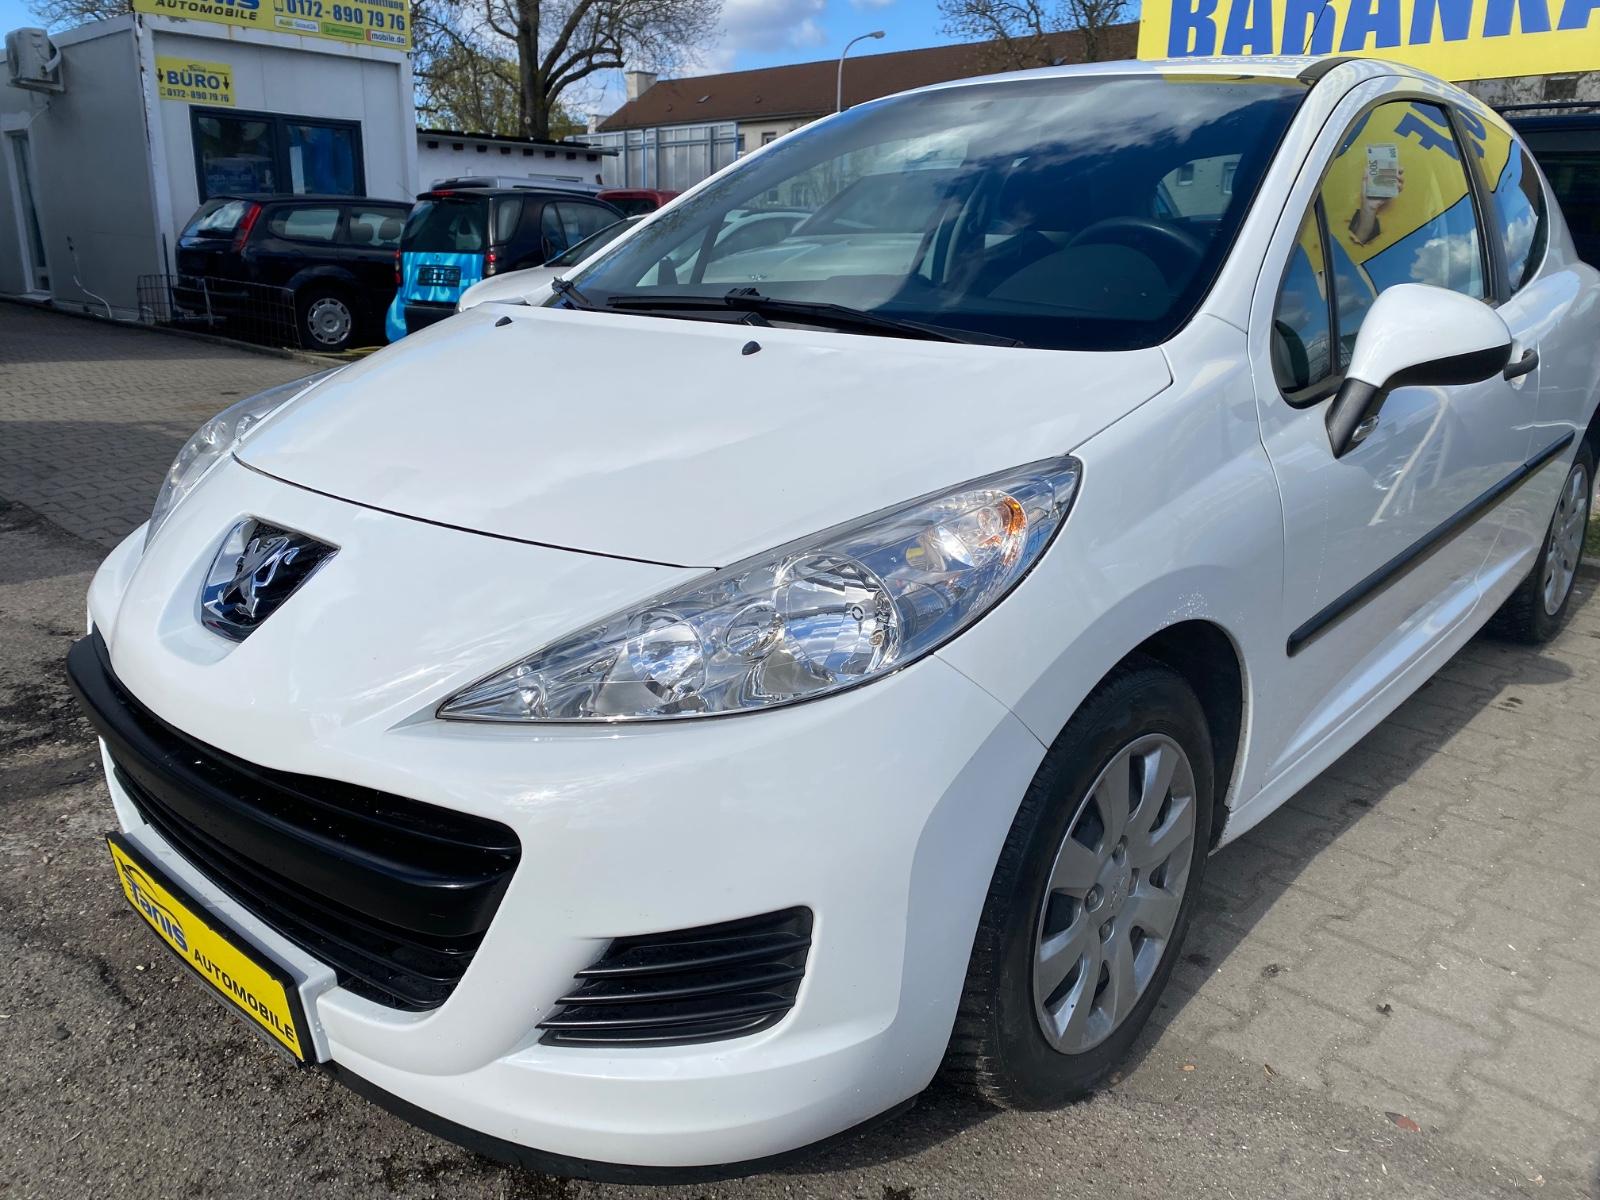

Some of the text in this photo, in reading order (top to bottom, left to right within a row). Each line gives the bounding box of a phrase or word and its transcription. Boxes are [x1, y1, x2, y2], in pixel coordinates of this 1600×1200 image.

[155, 0, 257, 20] AUTOMOBILE
[333, 4, 363, 24] 890
[367, 10, 384, 27] 79
[388, 13, 405, 31] 76
[167, 69, 220, 89] BÜRO
[194, 948, 296, 1044] AUTOMOBILE
